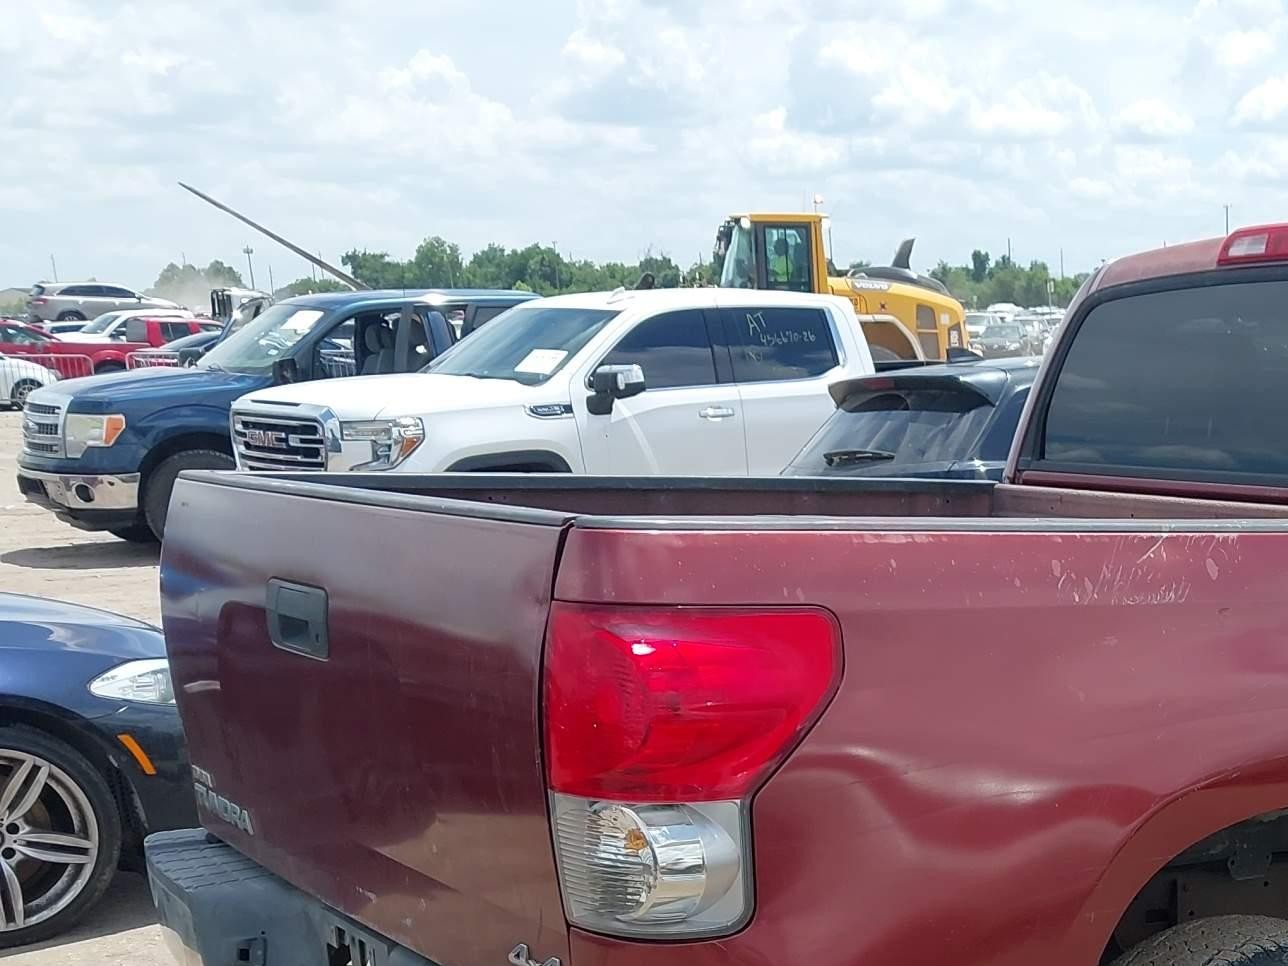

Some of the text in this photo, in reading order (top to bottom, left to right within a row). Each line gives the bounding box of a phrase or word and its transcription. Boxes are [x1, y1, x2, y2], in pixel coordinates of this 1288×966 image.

[854, 281, 889, 290] VOLVO
[746, 311, 767, 337] AT
[247, 430, 286, 448] GMC
